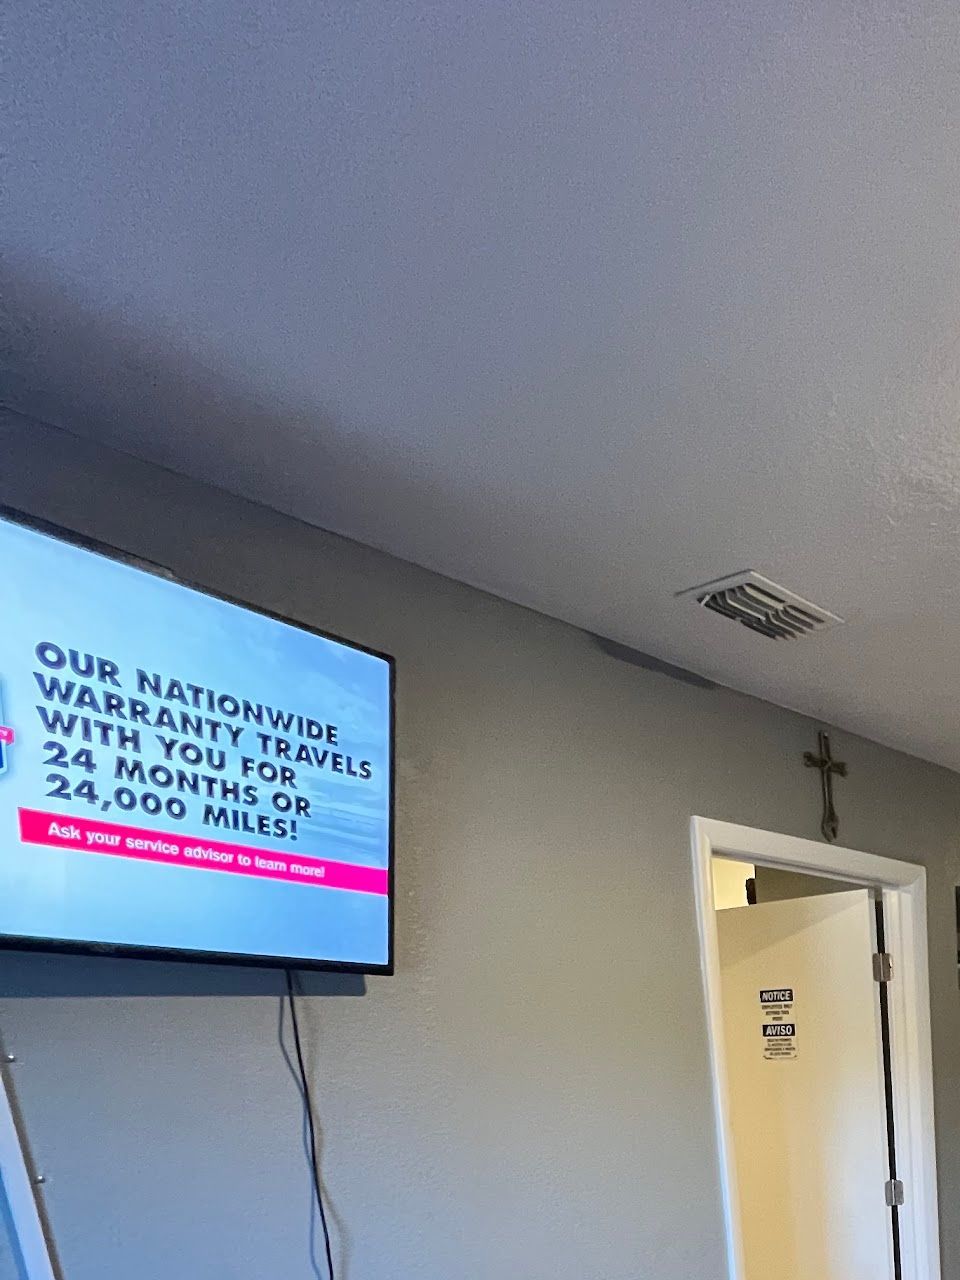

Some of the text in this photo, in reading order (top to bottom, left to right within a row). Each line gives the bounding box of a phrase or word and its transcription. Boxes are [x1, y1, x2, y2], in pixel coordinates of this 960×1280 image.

[33, 672, 373, 780] WARRANTY TRAVELS
[34, 641, 339, 747] OUR NATIONWIDE
[35, 705, 299, 789] WITH YOU FOR
[42, 740, 312, 818] 24 MONTHS OR
[45, 773, 299, 841] 24,000 MILES!
[48, 820, 326, 878] Ask your service advisor to learn more!
[762, 991, 791, 1001] NOTICE
[766, 1025, 792, 1035] AVISO
